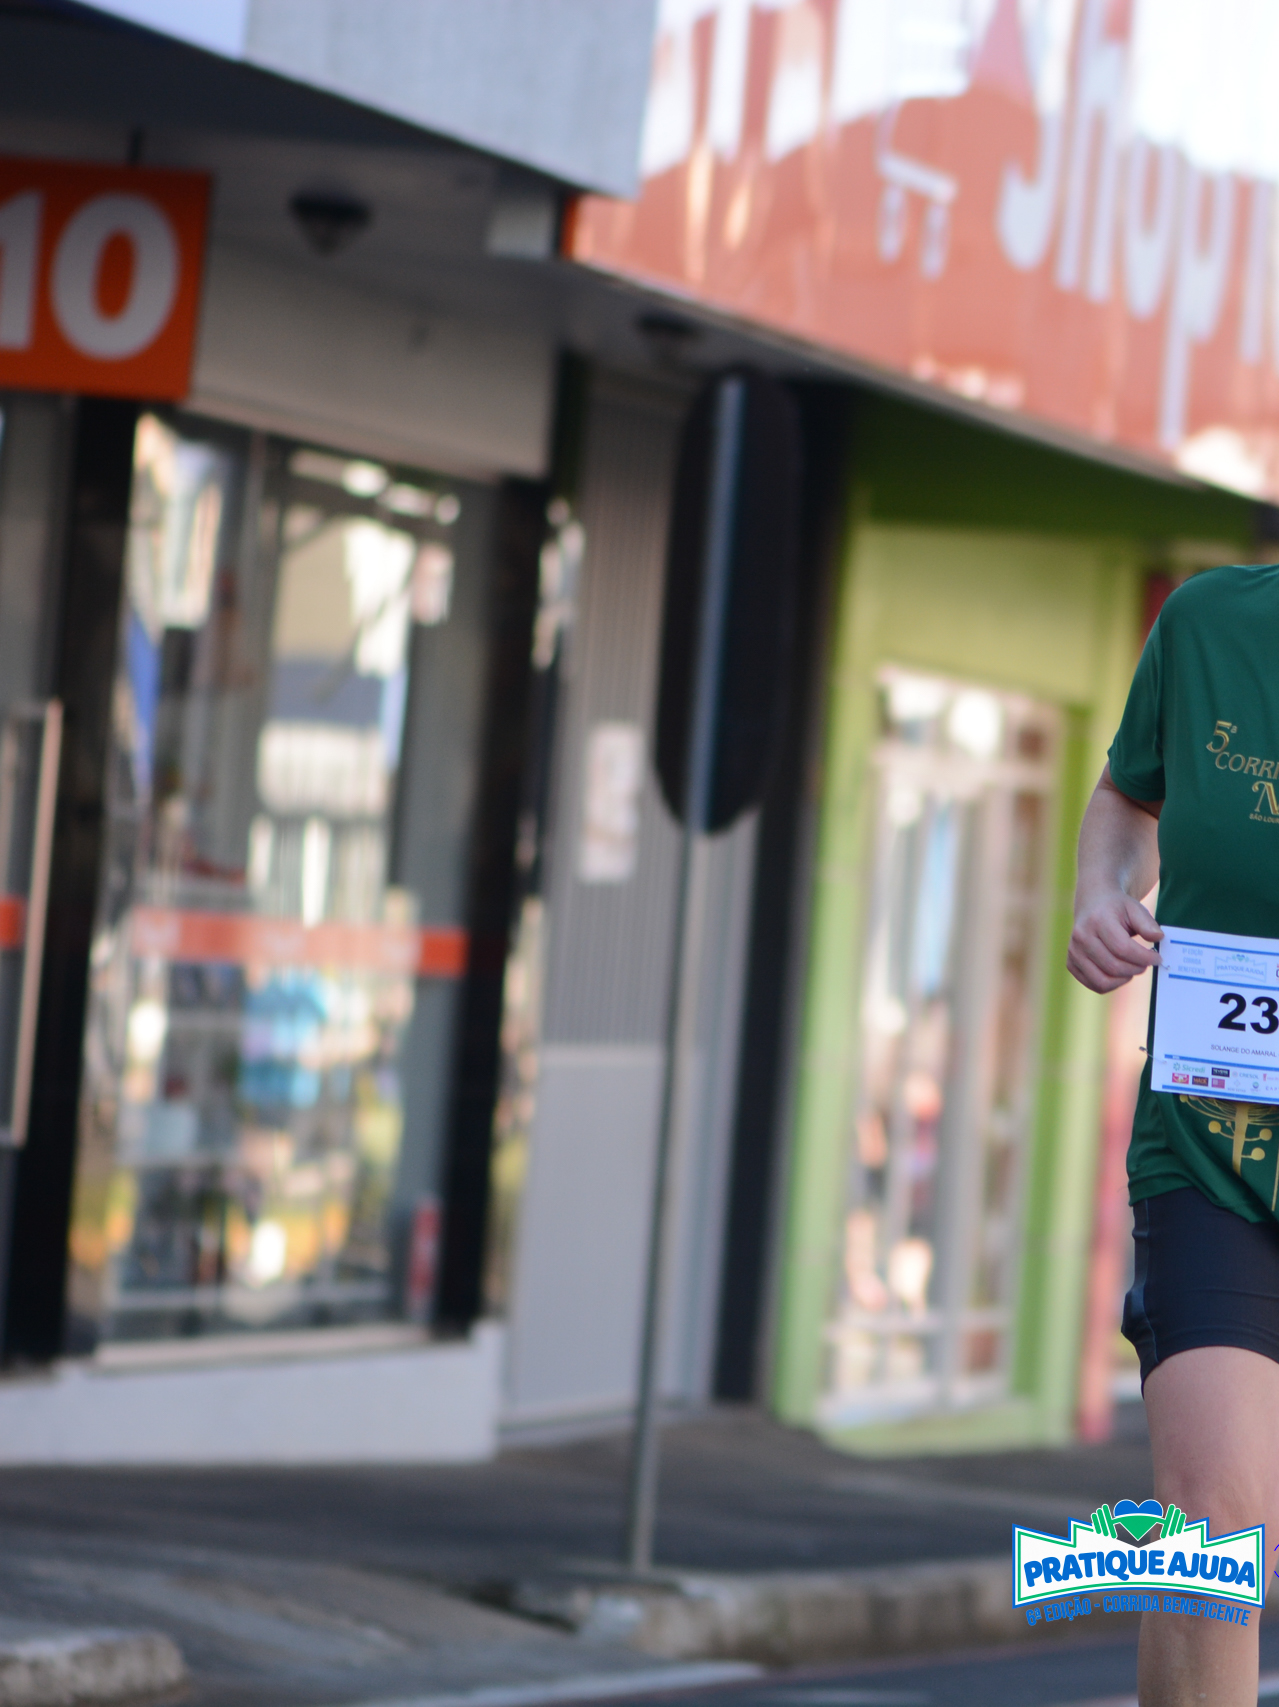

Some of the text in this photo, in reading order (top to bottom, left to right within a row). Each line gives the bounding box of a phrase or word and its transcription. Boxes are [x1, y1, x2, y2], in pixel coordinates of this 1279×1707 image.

[0, 190, 181, 361] 10
[1249, 813, 1263, 821] SÃO
[1216, 965, 1244, 973] PRATIQUE
[1210, 1044, 1239, 1054] SOLANGE
[1251, 1049, 1277, 1058] AMARAL
[1182, 1064, 1206, 1073] Sicredi
